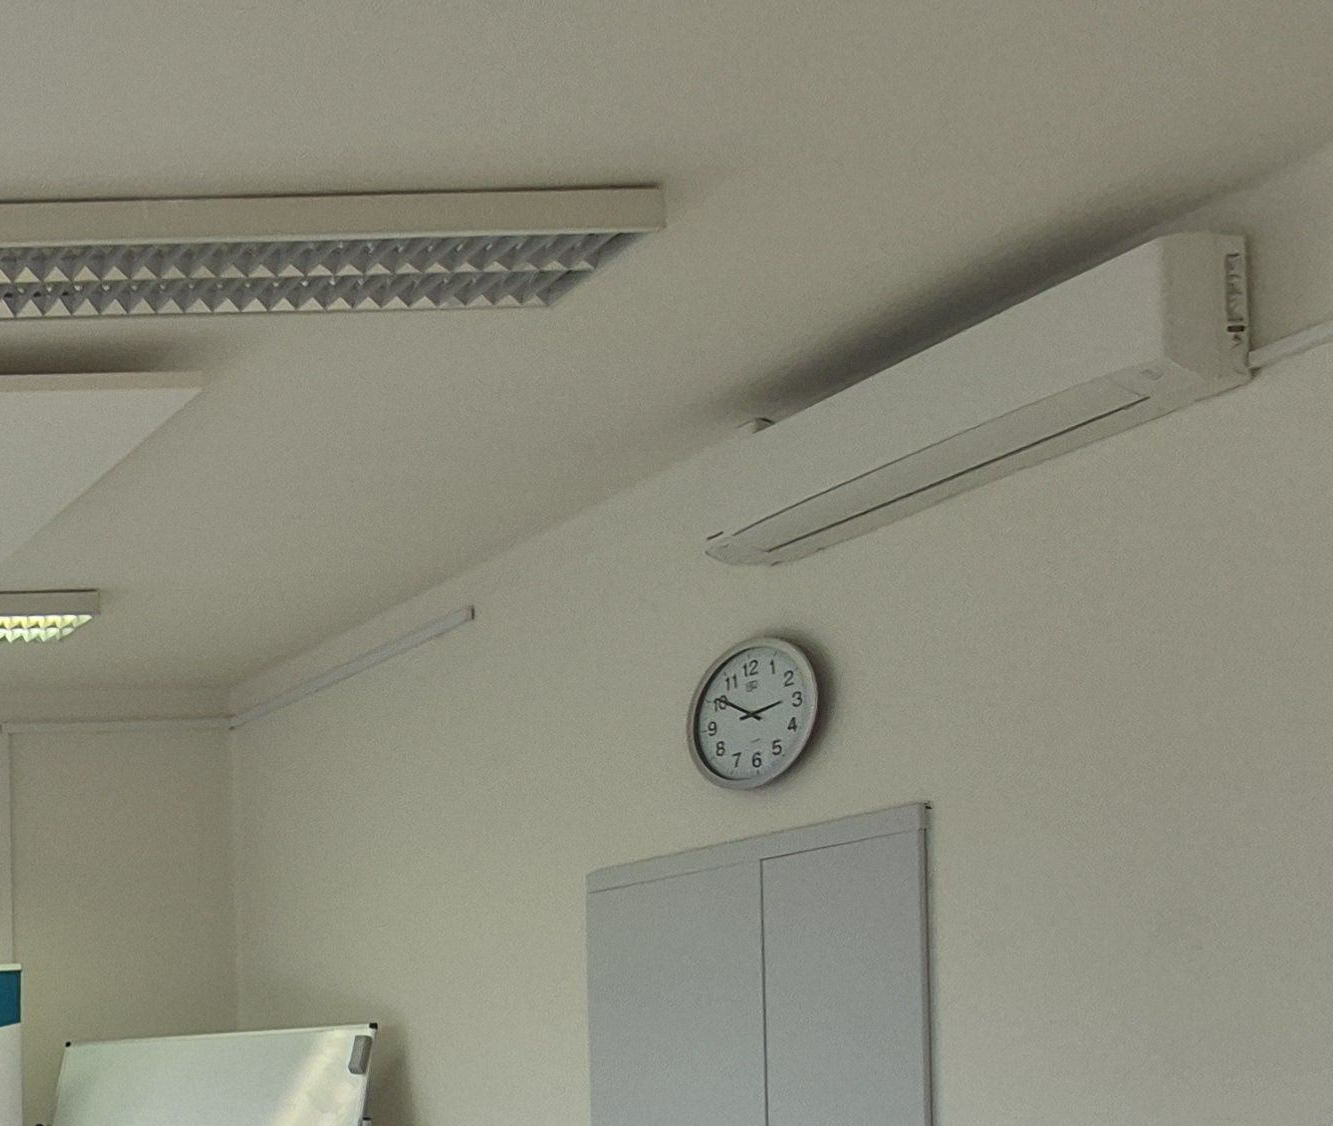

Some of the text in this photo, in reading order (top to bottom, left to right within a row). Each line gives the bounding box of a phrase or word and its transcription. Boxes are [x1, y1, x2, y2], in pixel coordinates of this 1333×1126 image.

[743, 659, 759, 678] 12
[770, 659, 776, 675] 1
[725, 674, 738, 691] 11
[783, 670, 795, 687] 2
[713, 695, 728, 712] 10
[791, 691, 803, 707] 3
[707, 721, 718, 736] 9
[787, 717, 797, 732] 4
[716, 741, 726, 757] 8
[772, 739, 783, 756] 5
[732, 752, 743, 767] 7
[751, 752, 762, 768] 6
